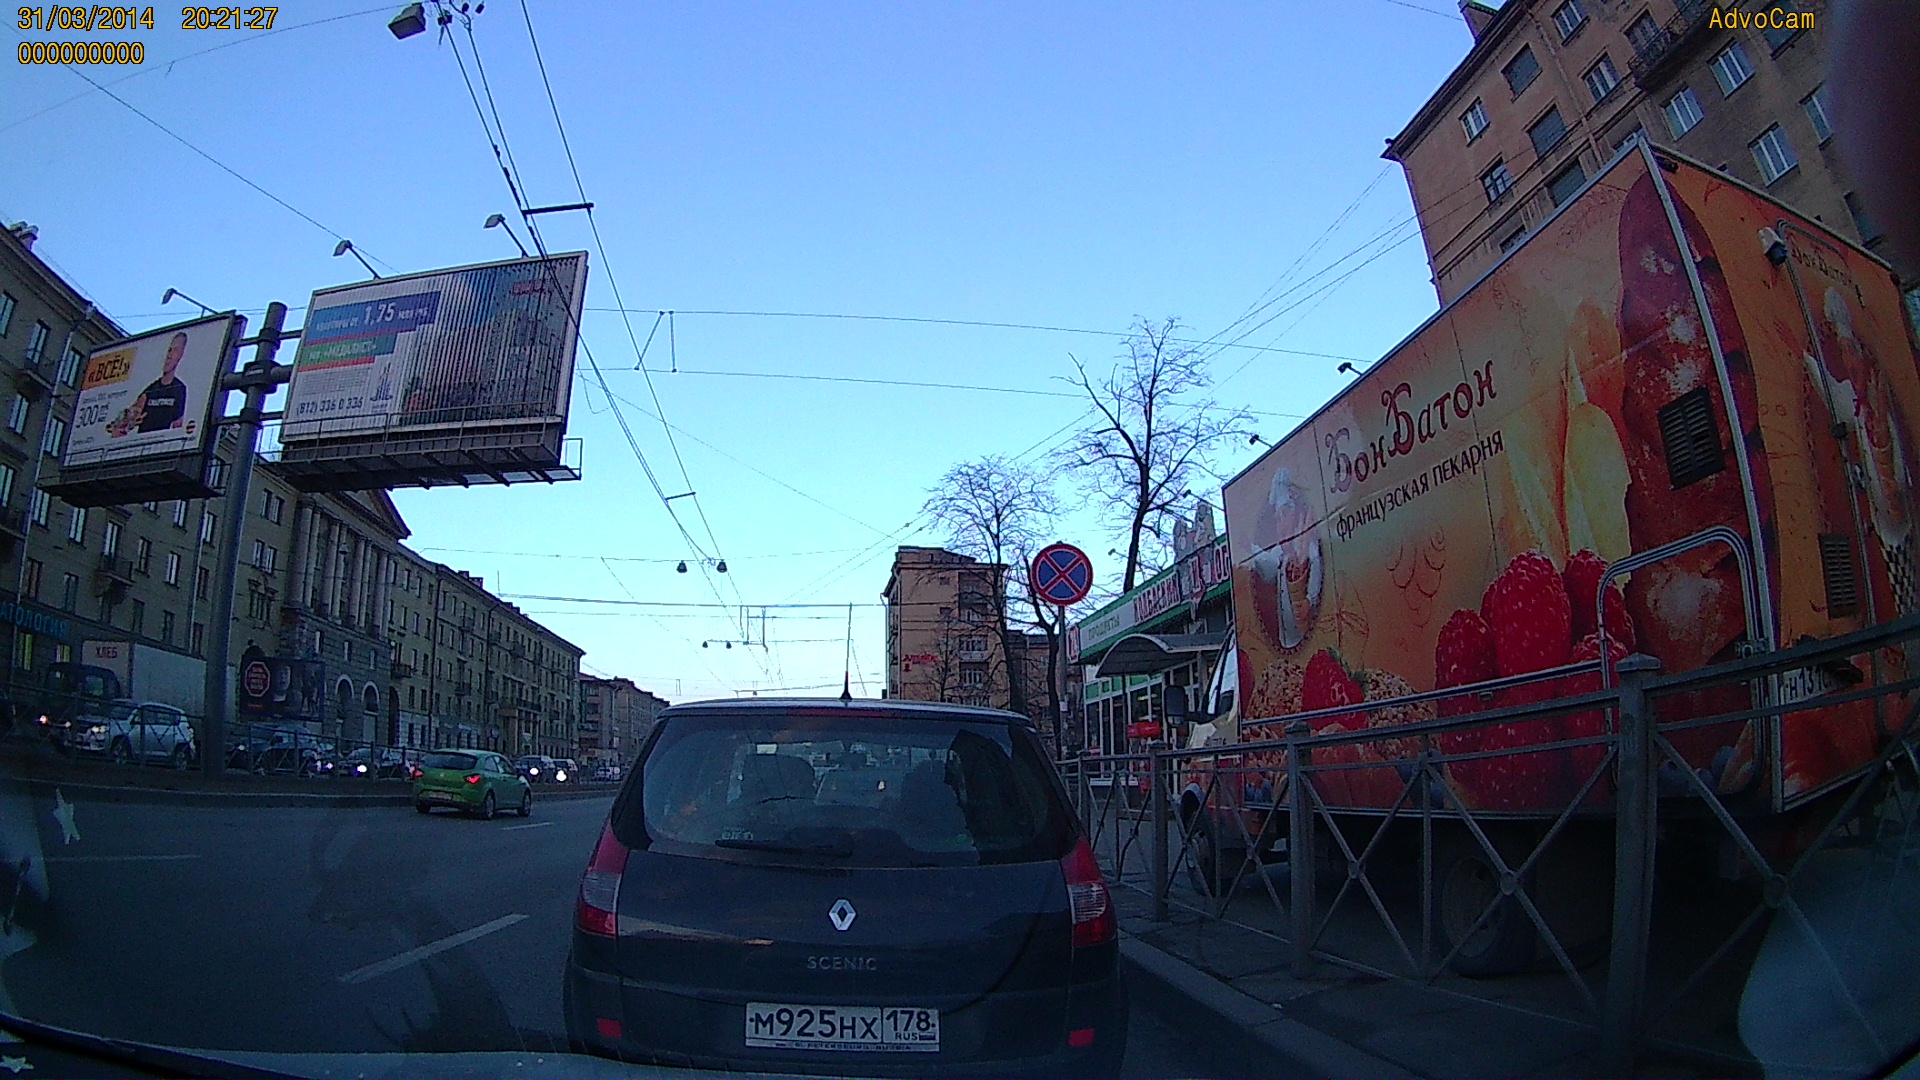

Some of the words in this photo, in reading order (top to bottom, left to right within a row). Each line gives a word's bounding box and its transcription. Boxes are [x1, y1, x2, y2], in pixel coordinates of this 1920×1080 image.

[365, 302, 396, 325] 1,75
[88, 355, 130, 383] «ВСЁ!»
[1432, 430, 1505, 487] ПЕКАРНЯ
[96, 645, 118, 660] ХЛЕБ
[806, 955, 878, 971] SCENIC
[885, 1009, 931, 1032] 178
[895, 1032, 918, 1041] RUS
